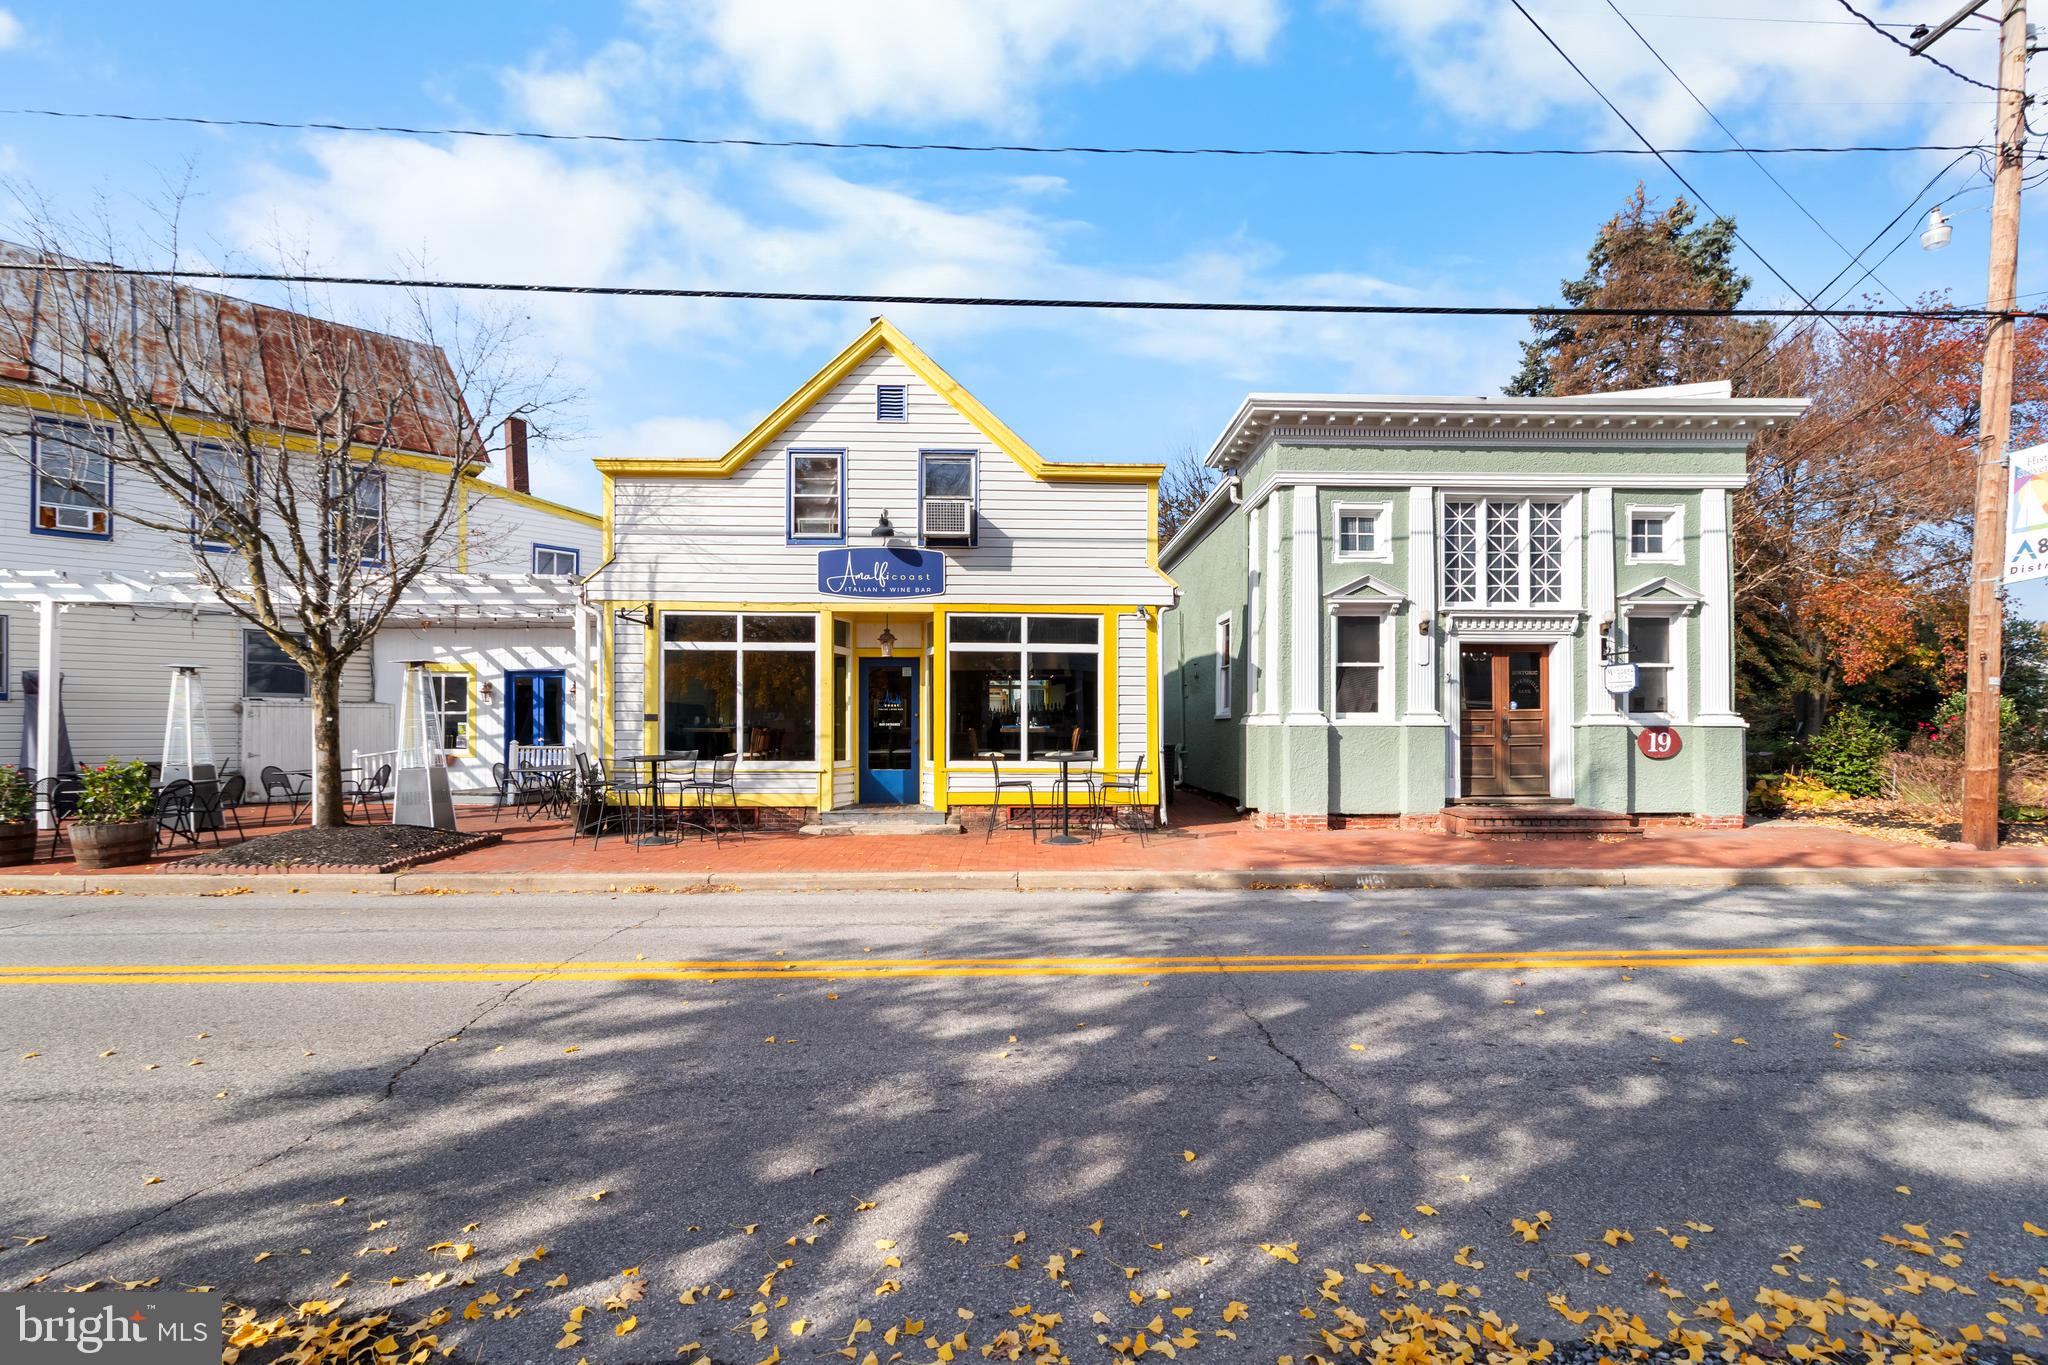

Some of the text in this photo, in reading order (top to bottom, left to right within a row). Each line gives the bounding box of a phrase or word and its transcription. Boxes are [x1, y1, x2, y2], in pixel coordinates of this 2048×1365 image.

[826, 551, 931, 593] Amalfi coast
[1647, 732, 1672, 752] 19
